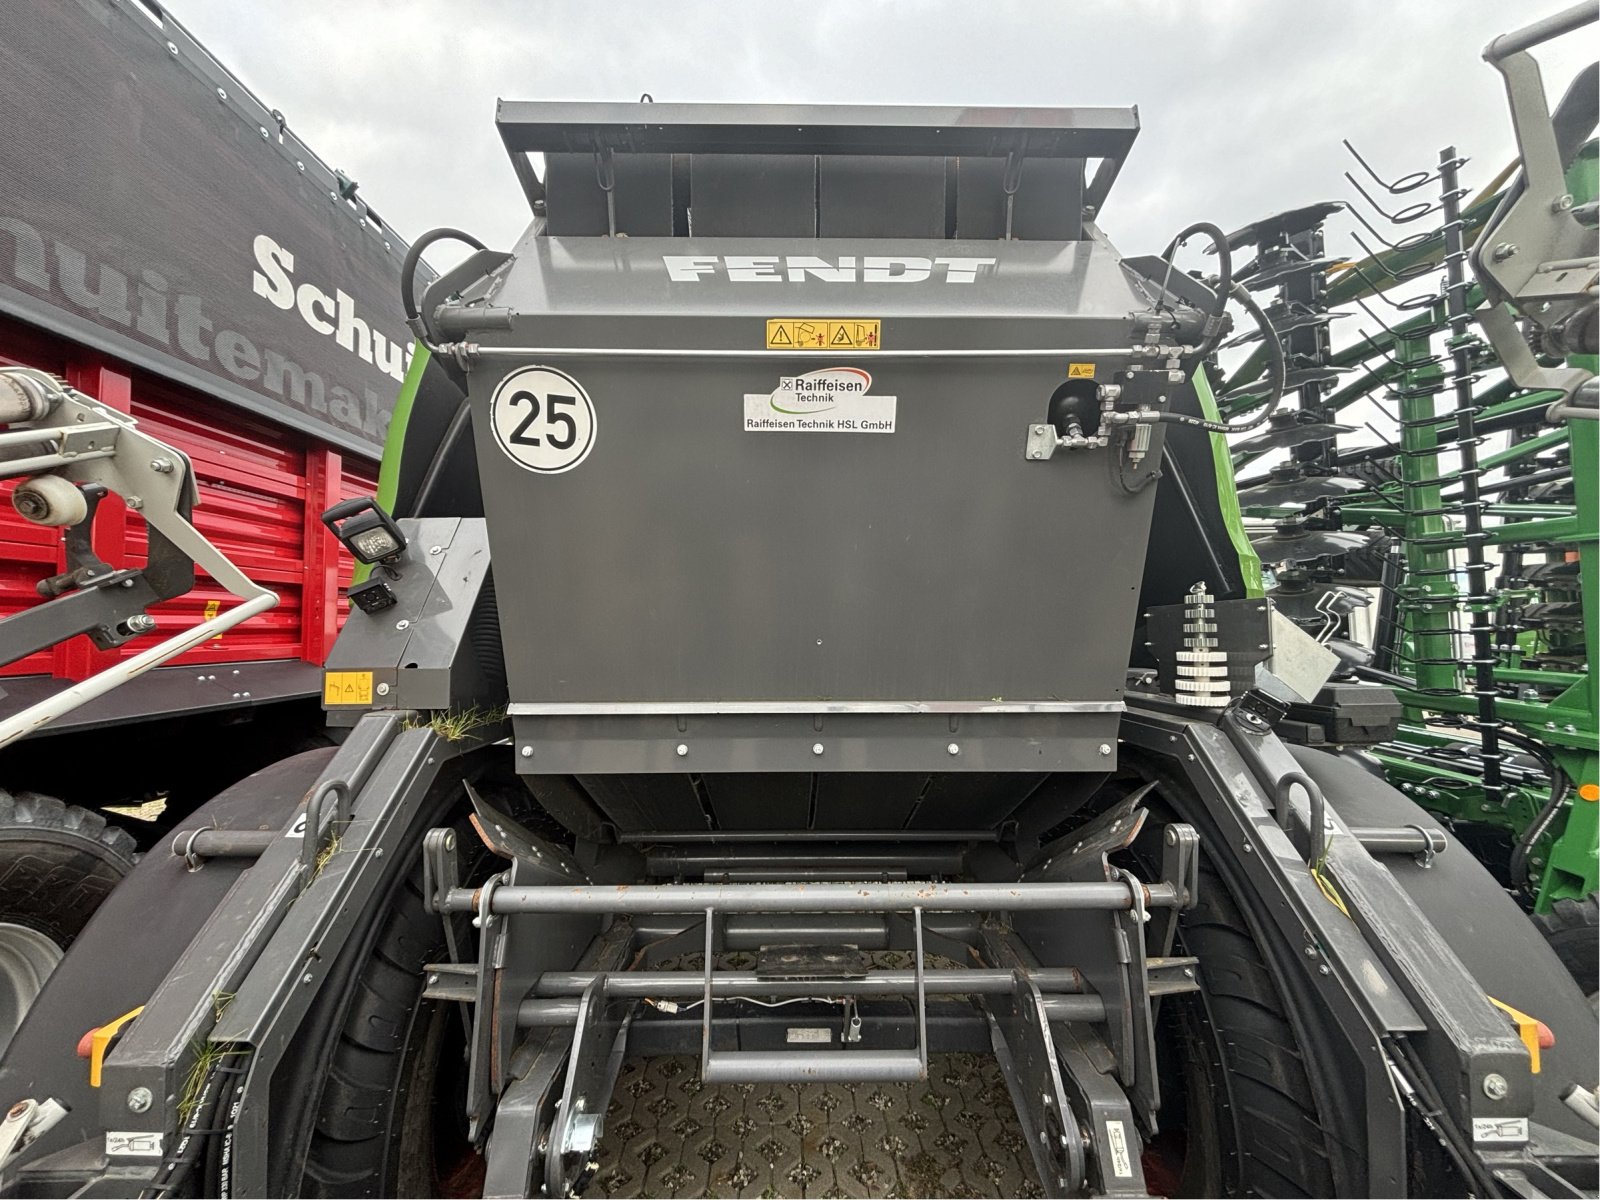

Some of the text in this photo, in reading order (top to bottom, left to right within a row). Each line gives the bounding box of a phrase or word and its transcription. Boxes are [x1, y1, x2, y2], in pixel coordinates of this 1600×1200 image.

[663, 256, 996, 283] FENDT
[795, 378, 862, 392] Raiffeisen
[795, 393, 834, 402] Technik
[509, 390, 577, 450] 25
[746, 419, 893, 430] Raiffeisen Technik HSL GmbH
